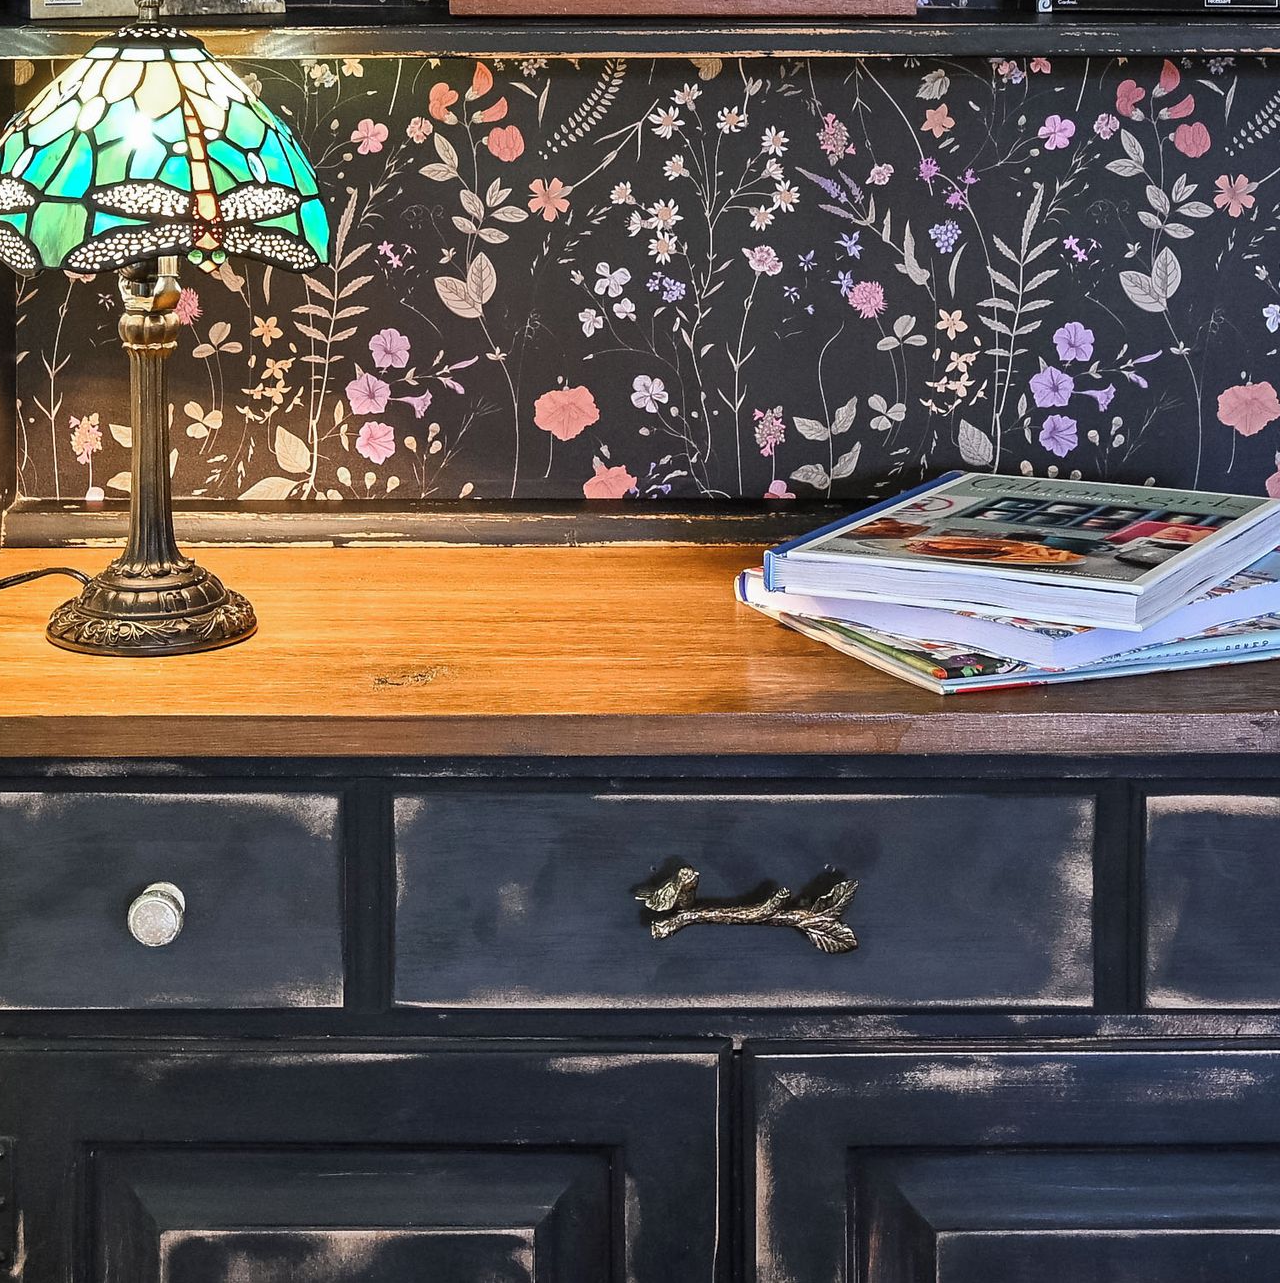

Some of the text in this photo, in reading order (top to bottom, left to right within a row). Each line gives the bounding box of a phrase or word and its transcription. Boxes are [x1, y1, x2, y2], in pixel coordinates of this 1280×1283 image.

[971, 476, 1250, 511] Gilmore girls
[992, 488, 1054, 498] OFFICIAL
[1056, 494, 1131, 504] COOKBOOK
